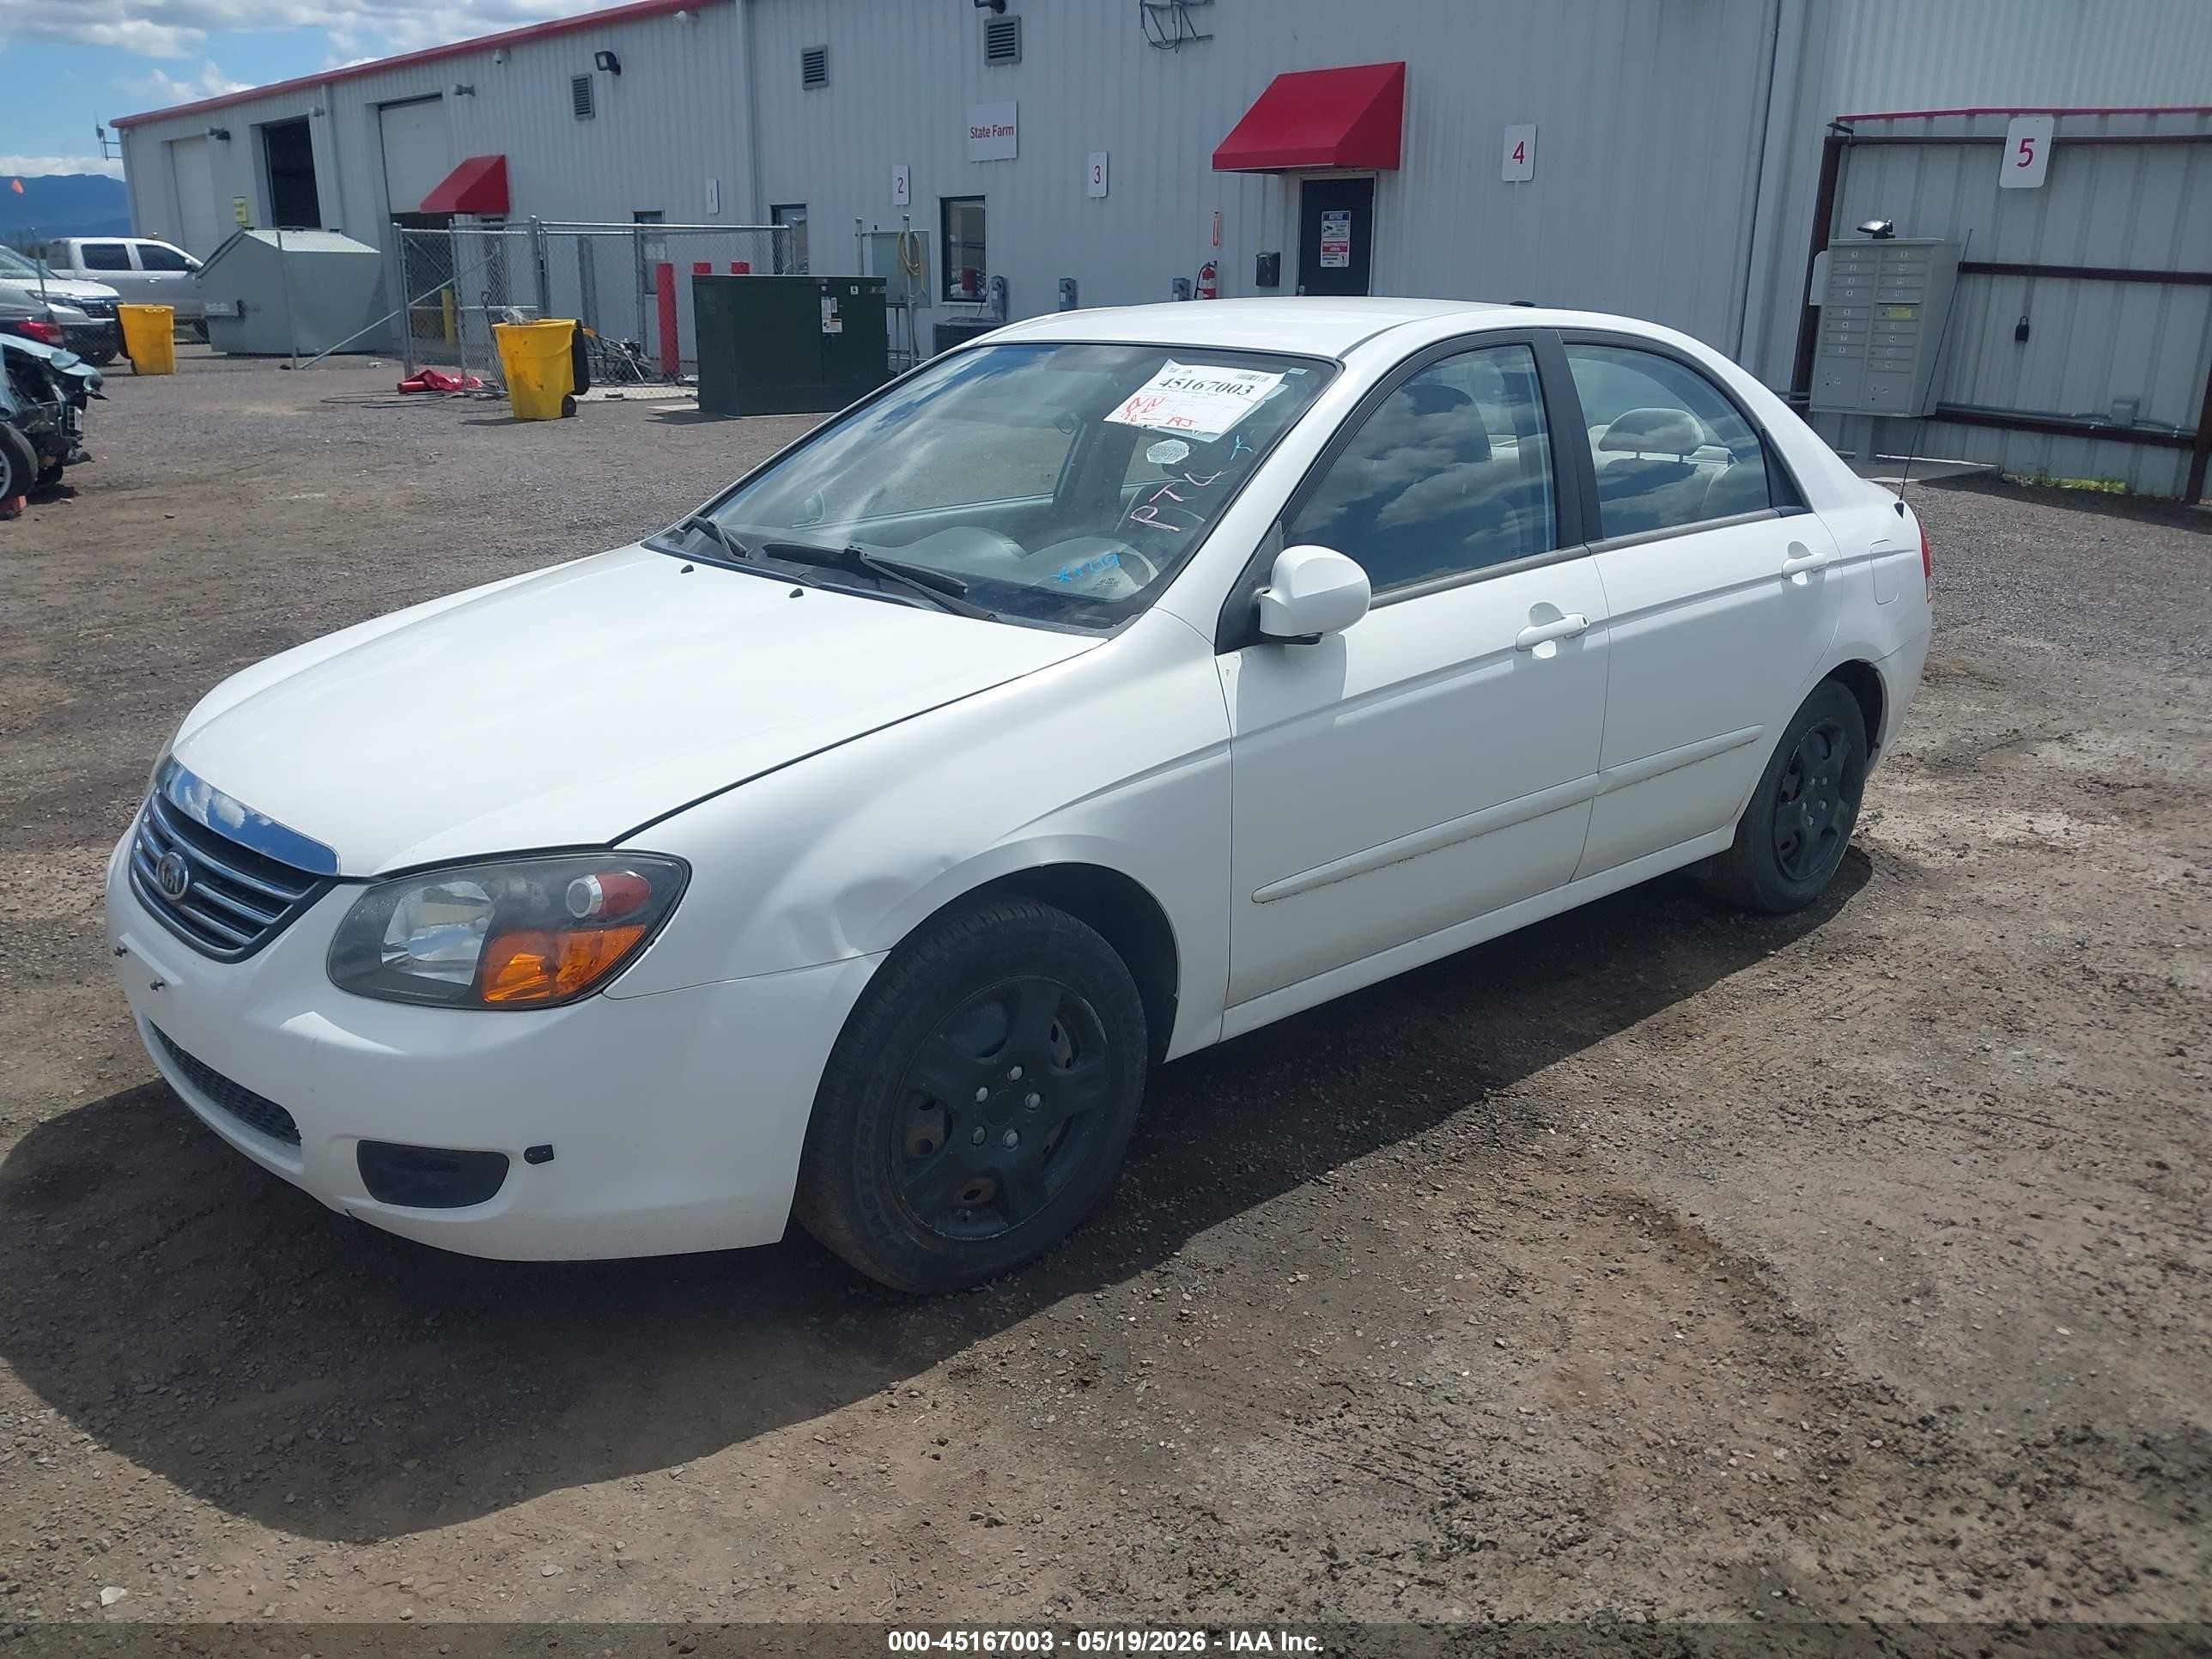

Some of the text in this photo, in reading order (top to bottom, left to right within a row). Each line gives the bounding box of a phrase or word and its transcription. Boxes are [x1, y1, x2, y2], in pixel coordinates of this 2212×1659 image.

[969, 124, 1015, 139] State Farm
[1512, 140, 1525, 165] 4
[2016, 137, 2036, 167] 5
[896, 176, 905, 194] 2
[1093, 165, 1102, 185] 3
[1158, 376, 1255, 397] 45167003
